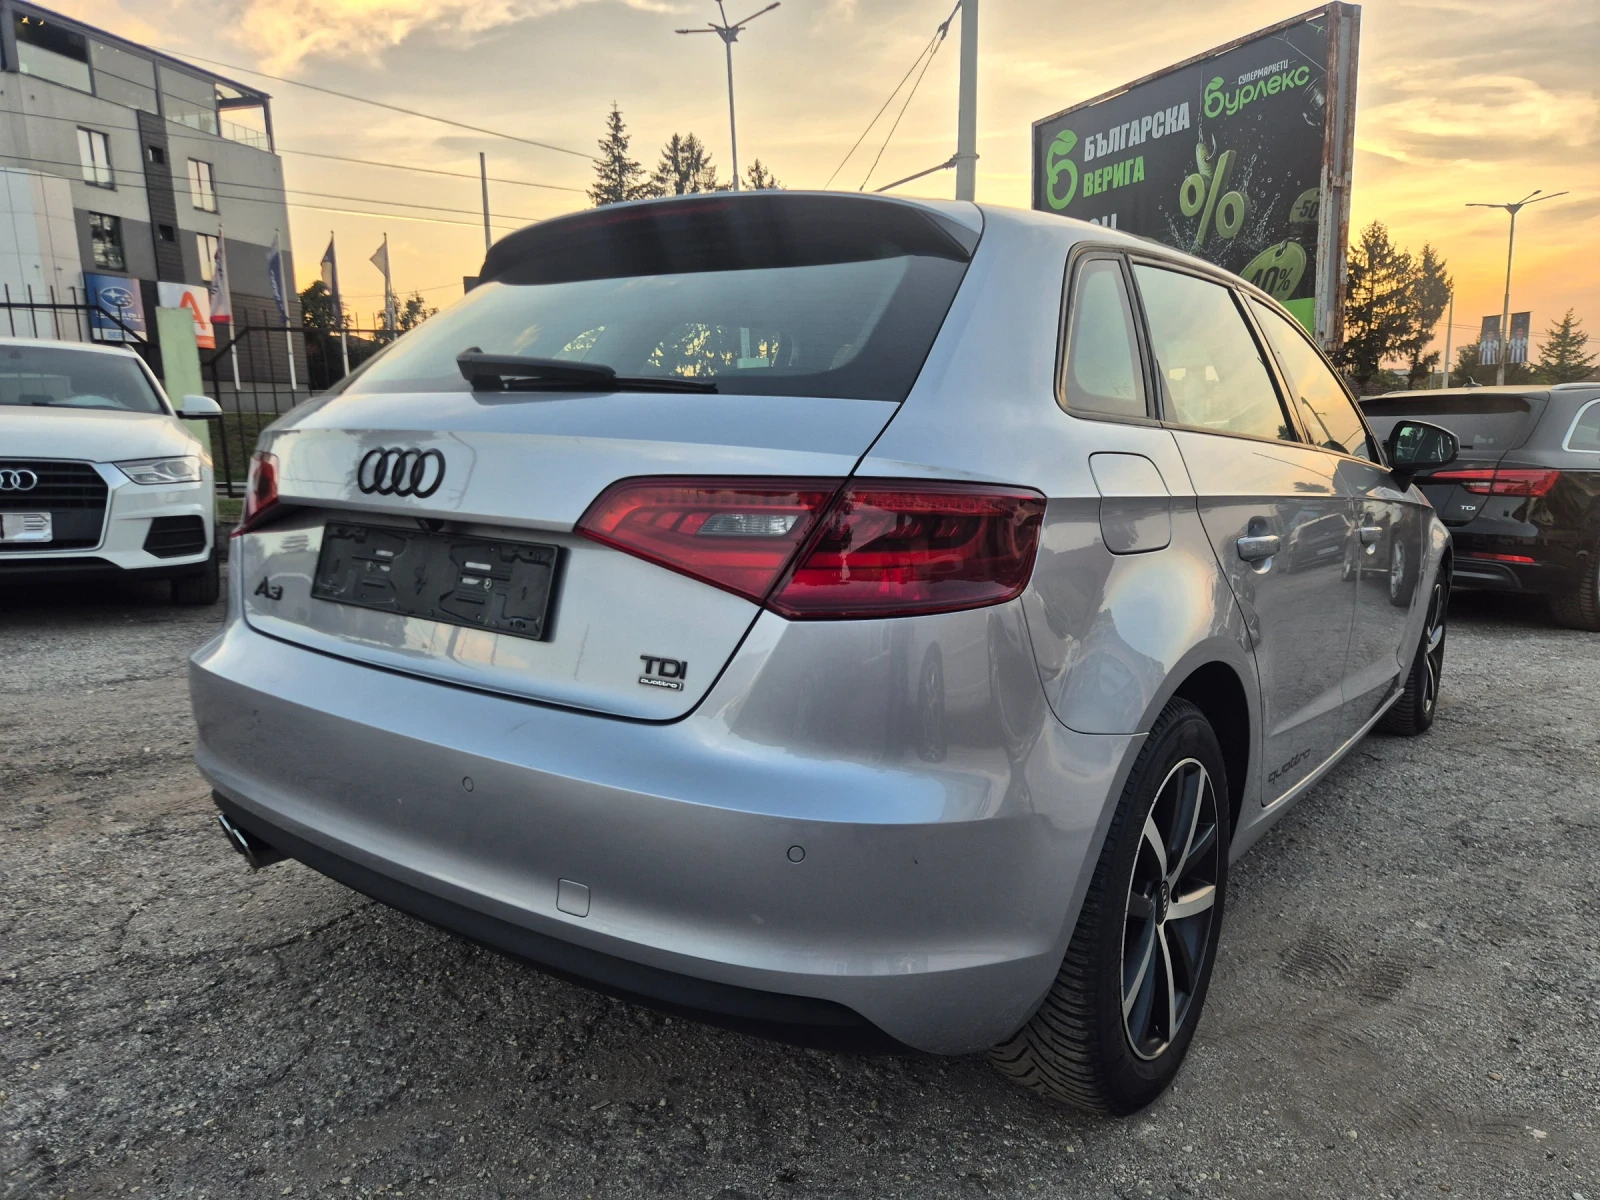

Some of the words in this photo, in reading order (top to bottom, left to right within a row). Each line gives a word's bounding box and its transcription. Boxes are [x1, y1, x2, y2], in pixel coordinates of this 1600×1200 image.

[1084, 102, 1191, 162] БЪЛГАРСКА
[1083, 156, 1145, 198] ВЕРИГА
[254, 576, 283, 601] A3
[640, 655, 688, 680] TDI
[640, 678, 678, 689] quattro
[1268, 748, 1311, 784] quattro
